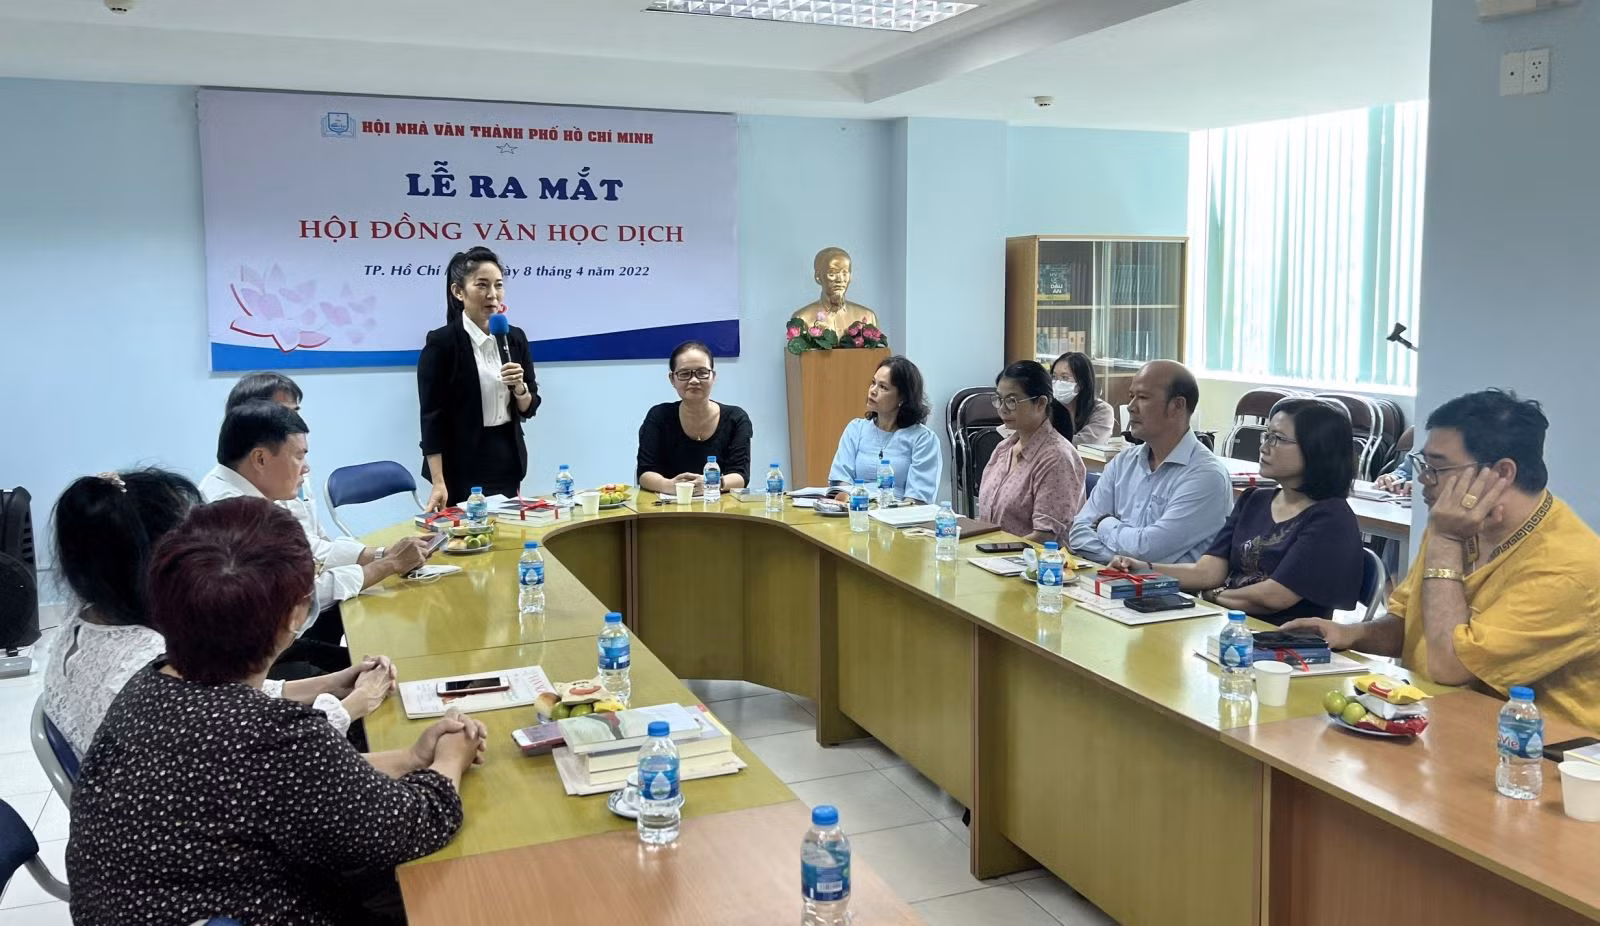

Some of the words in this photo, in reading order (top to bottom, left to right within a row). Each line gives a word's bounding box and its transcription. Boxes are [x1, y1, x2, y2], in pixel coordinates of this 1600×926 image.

[362, 118, 391, 136] HỘI
[396, 120, 429, 136] NHÀ
[434, 122, 465, 137] VĂN
[470, 124, 524, 140] THÀNH
[528, 125, 559, 141] PHỐ
[563, 126, 583, 142] HỒ
[587, 129, 612, 143] CHÍ
[617, 132, 654, 144] MINH
[405, 160, 457, 198] LỄ
[469, 175, 528, 199] RA
[538, 166, 624, 201] MẮT
[298, 214, 360, 243] HỘI
[369, 212, 463, 240] ĐỒNG
[472, 218, 537, 242] VĂN
[547, 223, 608, 246] HỌC
[617, 224, 684, 246] DỊCH
[364, 264, 385, 276] TP.
[390, 263, 413, 276] Hồ
[416, 264, 442, 276] Chí
[504, 265, 520, 280] ày
[523, 266, 532, 277] 8
[536, 265, 573, 280] tháng
[576, 266, 584, 277] 4
[587, 265, 615, 277] năm
[618, 266, 650, 277] 2022
